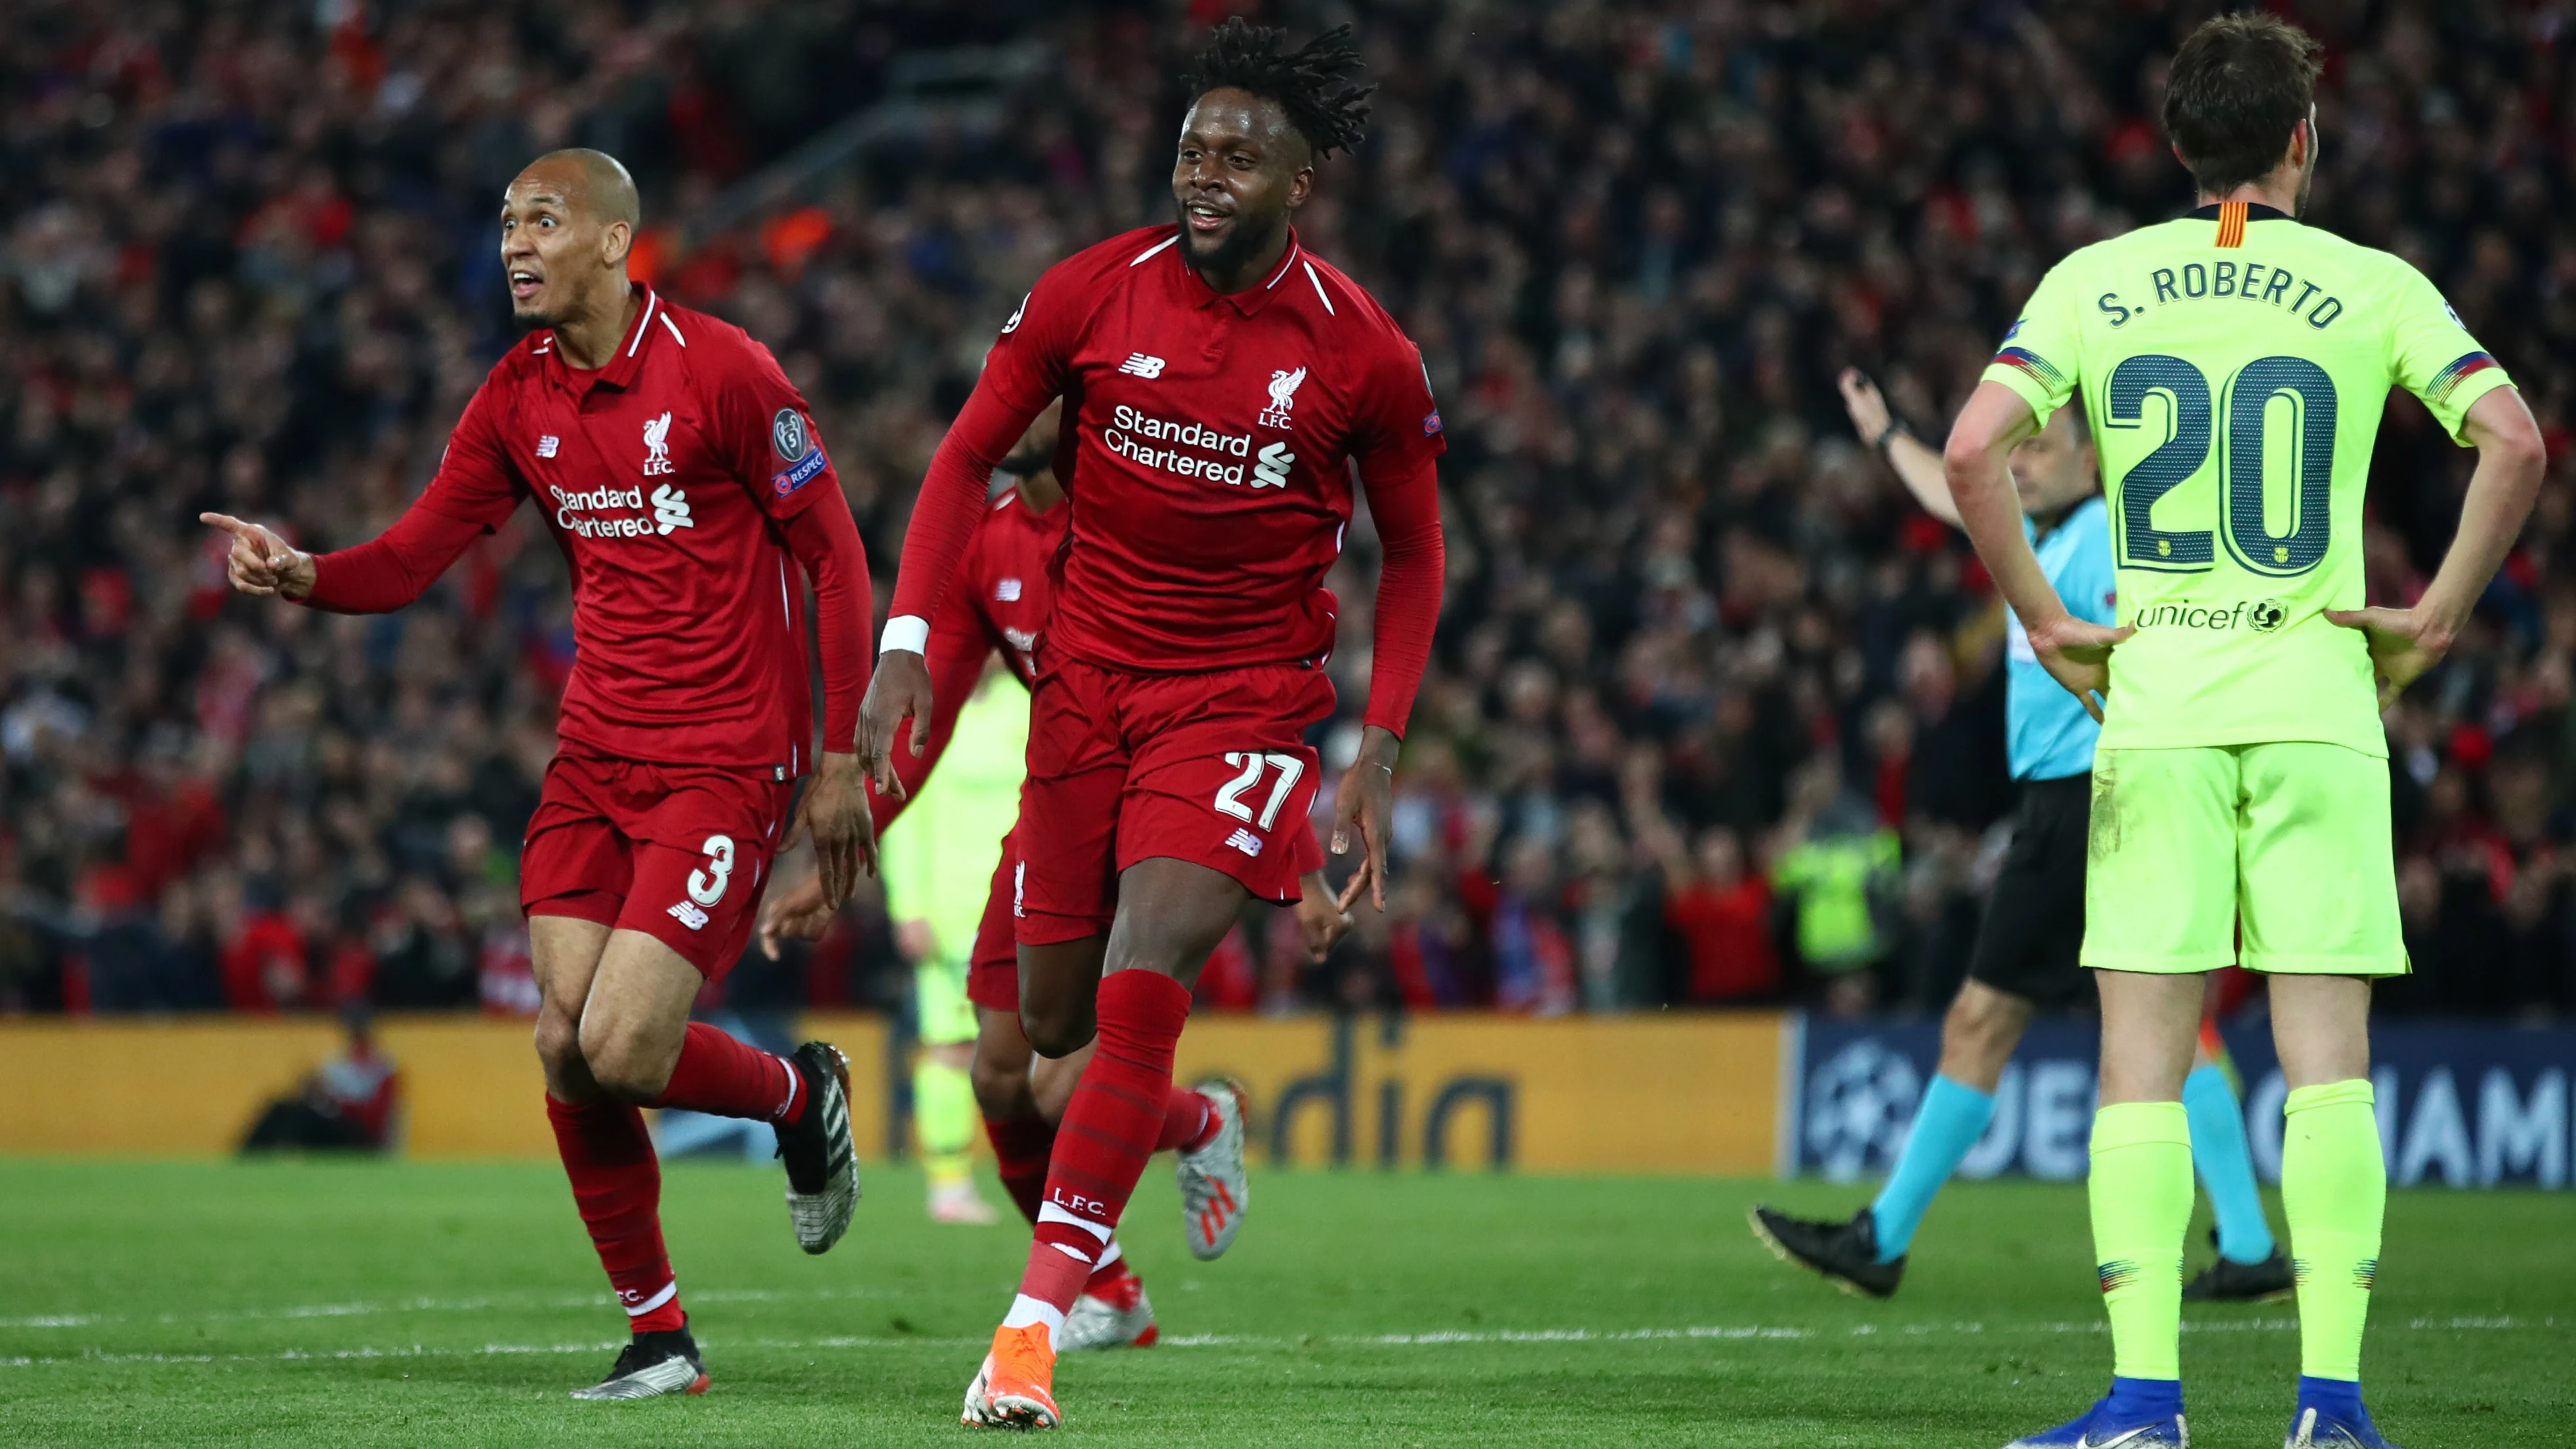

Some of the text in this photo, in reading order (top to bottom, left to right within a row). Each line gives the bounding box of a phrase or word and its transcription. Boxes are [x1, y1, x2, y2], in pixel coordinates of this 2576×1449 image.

[2098, 261, 2343, 330] S. ROBERTO
[787, 433, 797, 448] 5
[1113, 405, 1251, 458] Standard
[1258, 413, 1293, 430] L.F.C.
[644, 461, 675, 476] L.F.C.
[1104, 429, 1245, 485] Chartered
[2104, 354, 2338, 578] 20
[550, 484, 644, 511] Standard
[2135, 599, 2247, 630] unicef
[1215, 752, 1304, 832] 27
[687, 834, 735, 907] 3
[1053, 1187, 1106, 1216] L.F.C.
